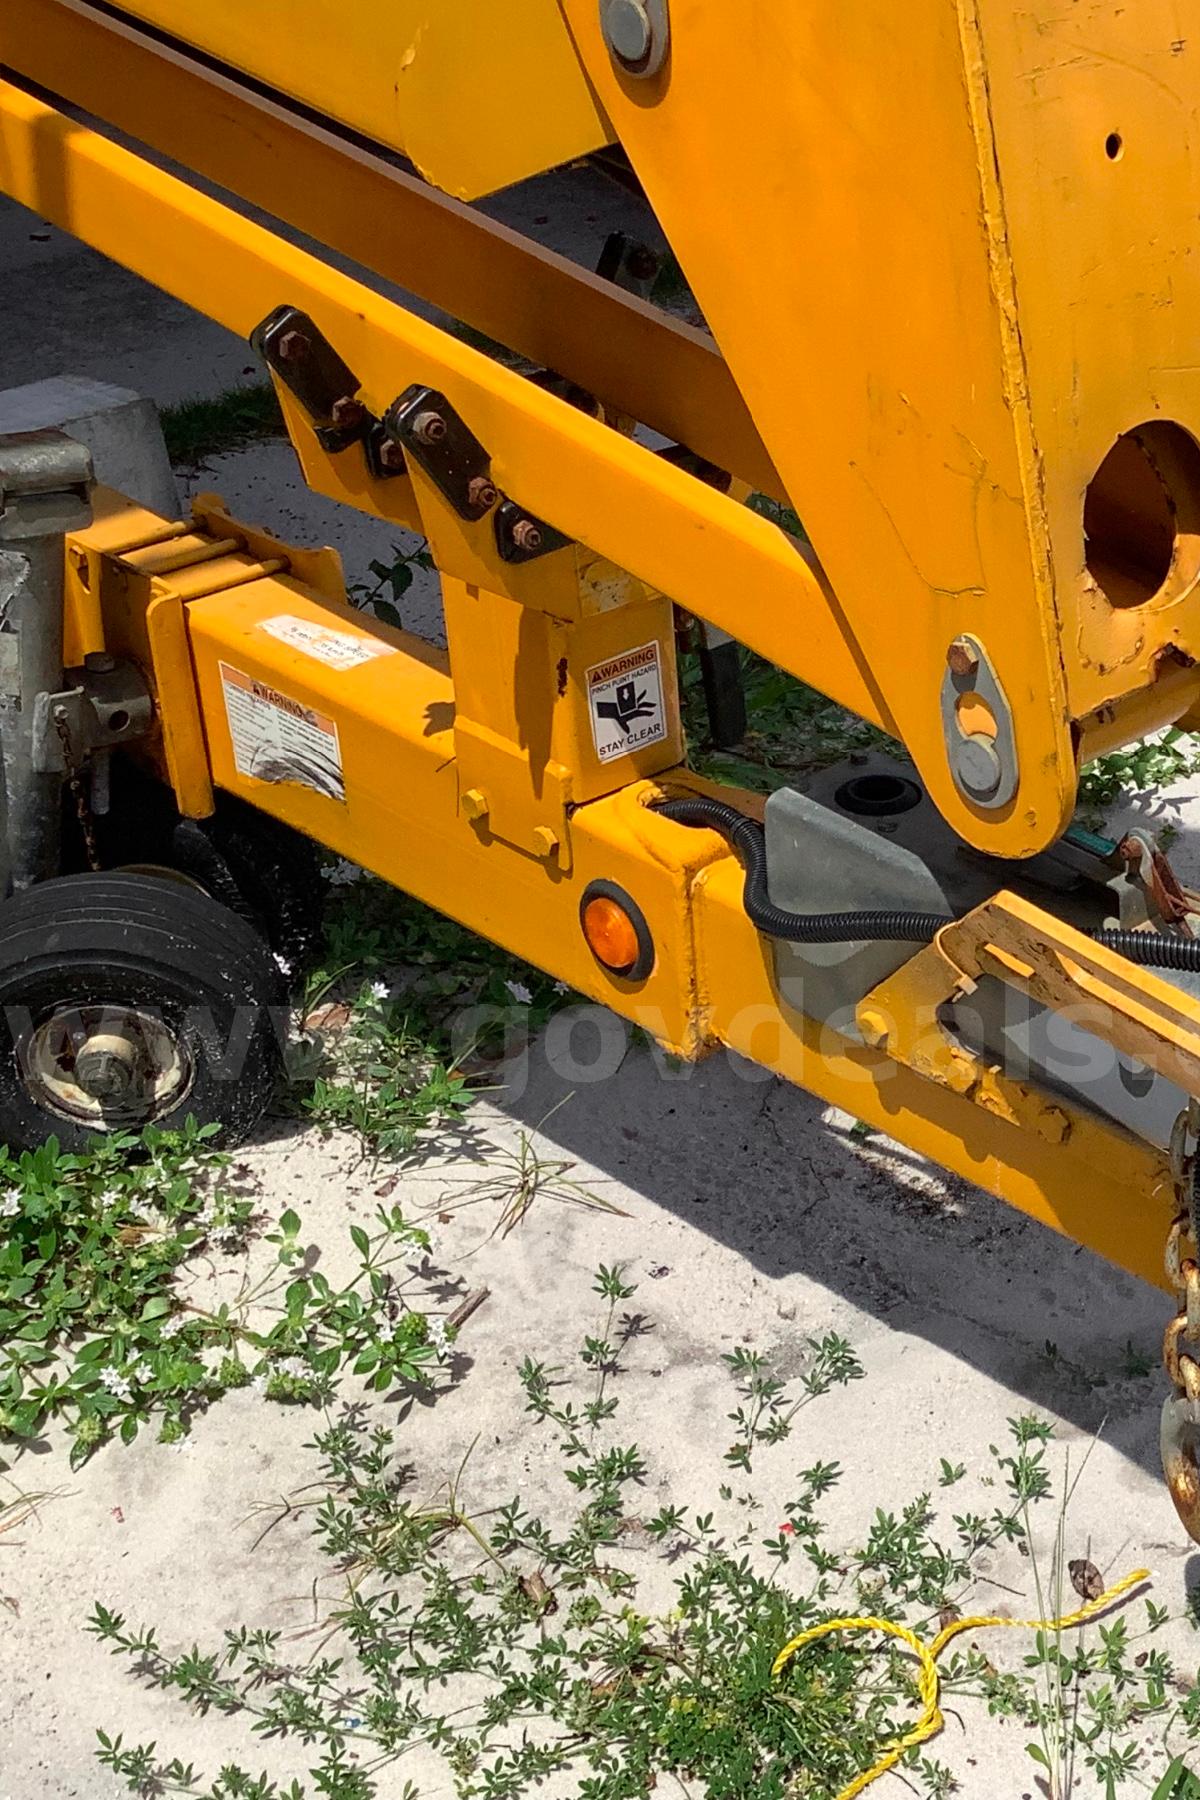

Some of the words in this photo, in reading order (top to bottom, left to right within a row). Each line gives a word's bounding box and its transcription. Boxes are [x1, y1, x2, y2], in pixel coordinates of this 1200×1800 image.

[592, 683, 611, 695] PINCH
[612, 672, 630, 688] POINT
[631, 664, 657, 679] HAZARD
[600, 650, 654, 677] WARNING
[260, 685, 305, 721] WARNING
[600, 739, 625, 756] STAY
[627, 723, 661, 745] CLEAR
